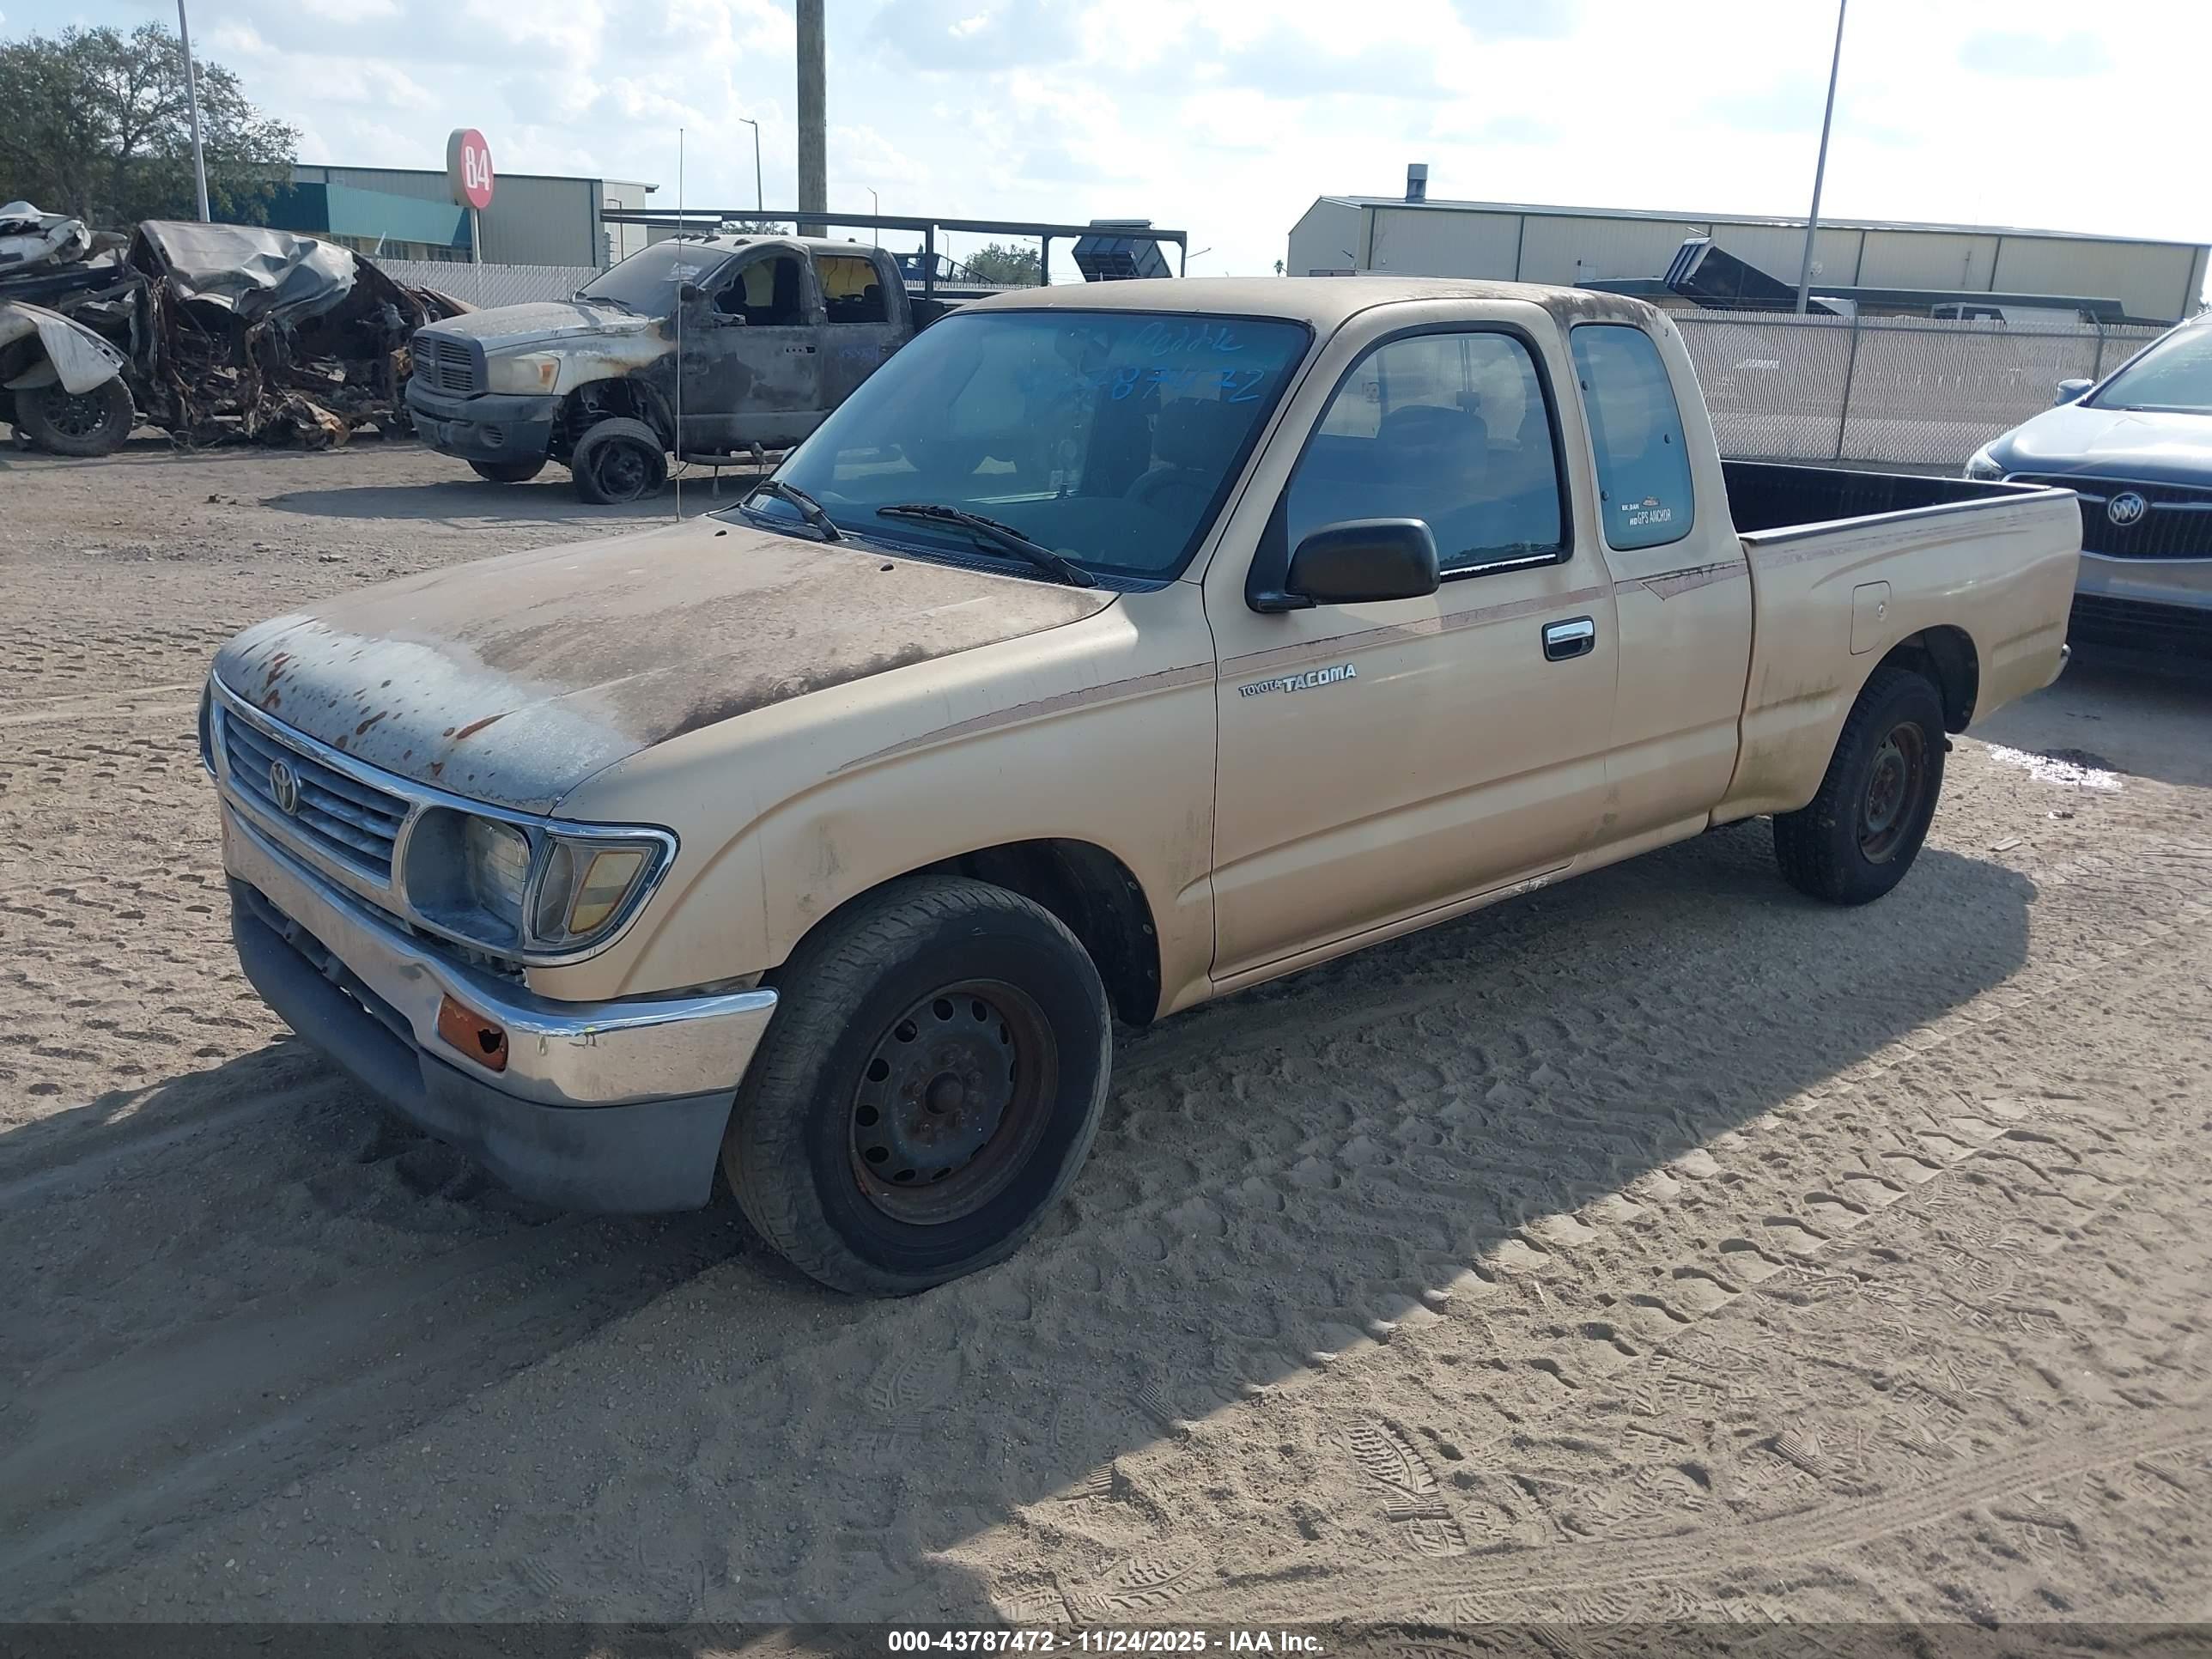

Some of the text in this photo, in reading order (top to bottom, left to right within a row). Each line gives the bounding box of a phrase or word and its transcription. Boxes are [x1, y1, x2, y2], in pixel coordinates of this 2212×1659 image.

[465, 145, 489, 191] 84
[1638, 511, 1649, 525] GPS
[1649, 508, 1672, 523] ANCHOR
[1239, 664, 1358, 697] TOYOTA TACOMA
